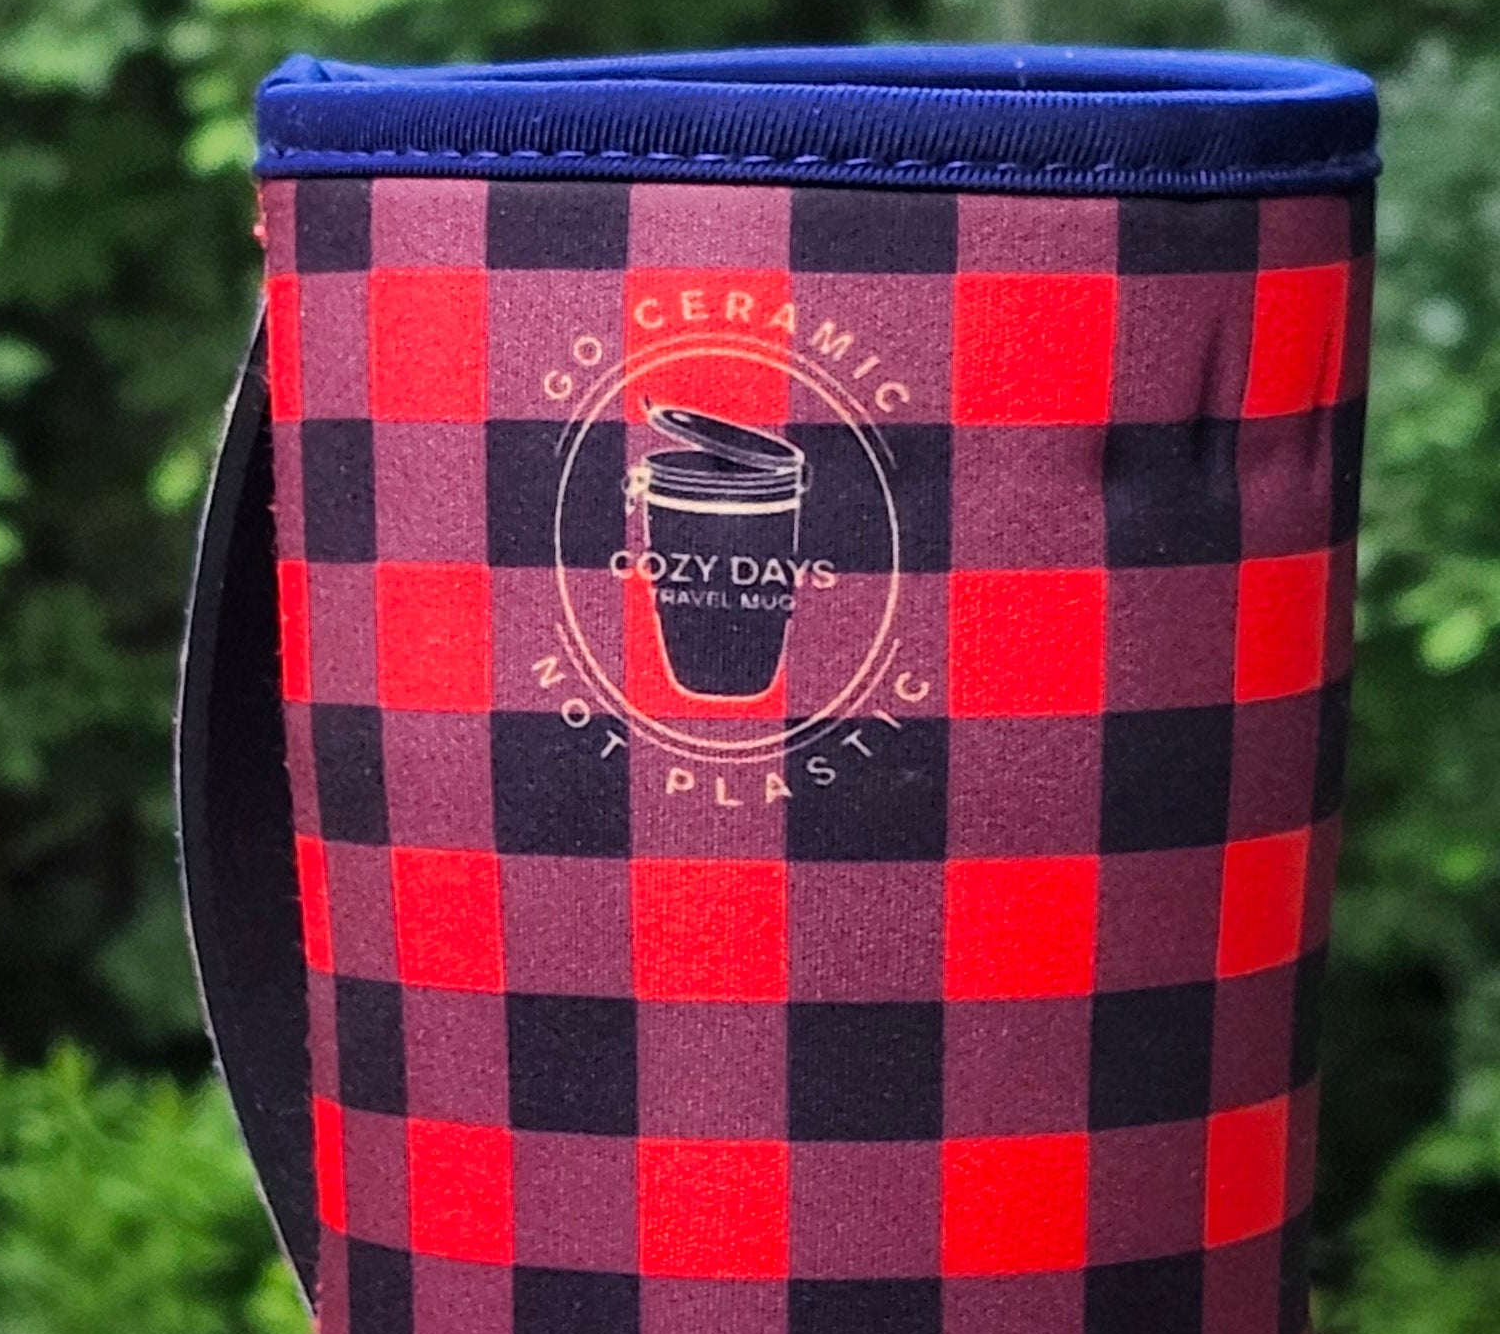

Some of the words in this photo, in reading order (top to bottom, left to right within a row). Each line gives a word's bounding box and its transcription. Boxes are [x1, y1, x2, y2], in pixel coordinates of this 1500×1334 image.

[543, 334, 603, 402] GO
[634, 290, 911, 414] CERAMIC
[609, 550, 718, 583] COZY
[730, 556, 838, 590] DAYS
[650, 587, 733, 609] TRAVEL
[740, 592, 796, 611] MUG
[531, 655, 629, 760] NOT
[665, 670, 930, 808] PLASTIC
